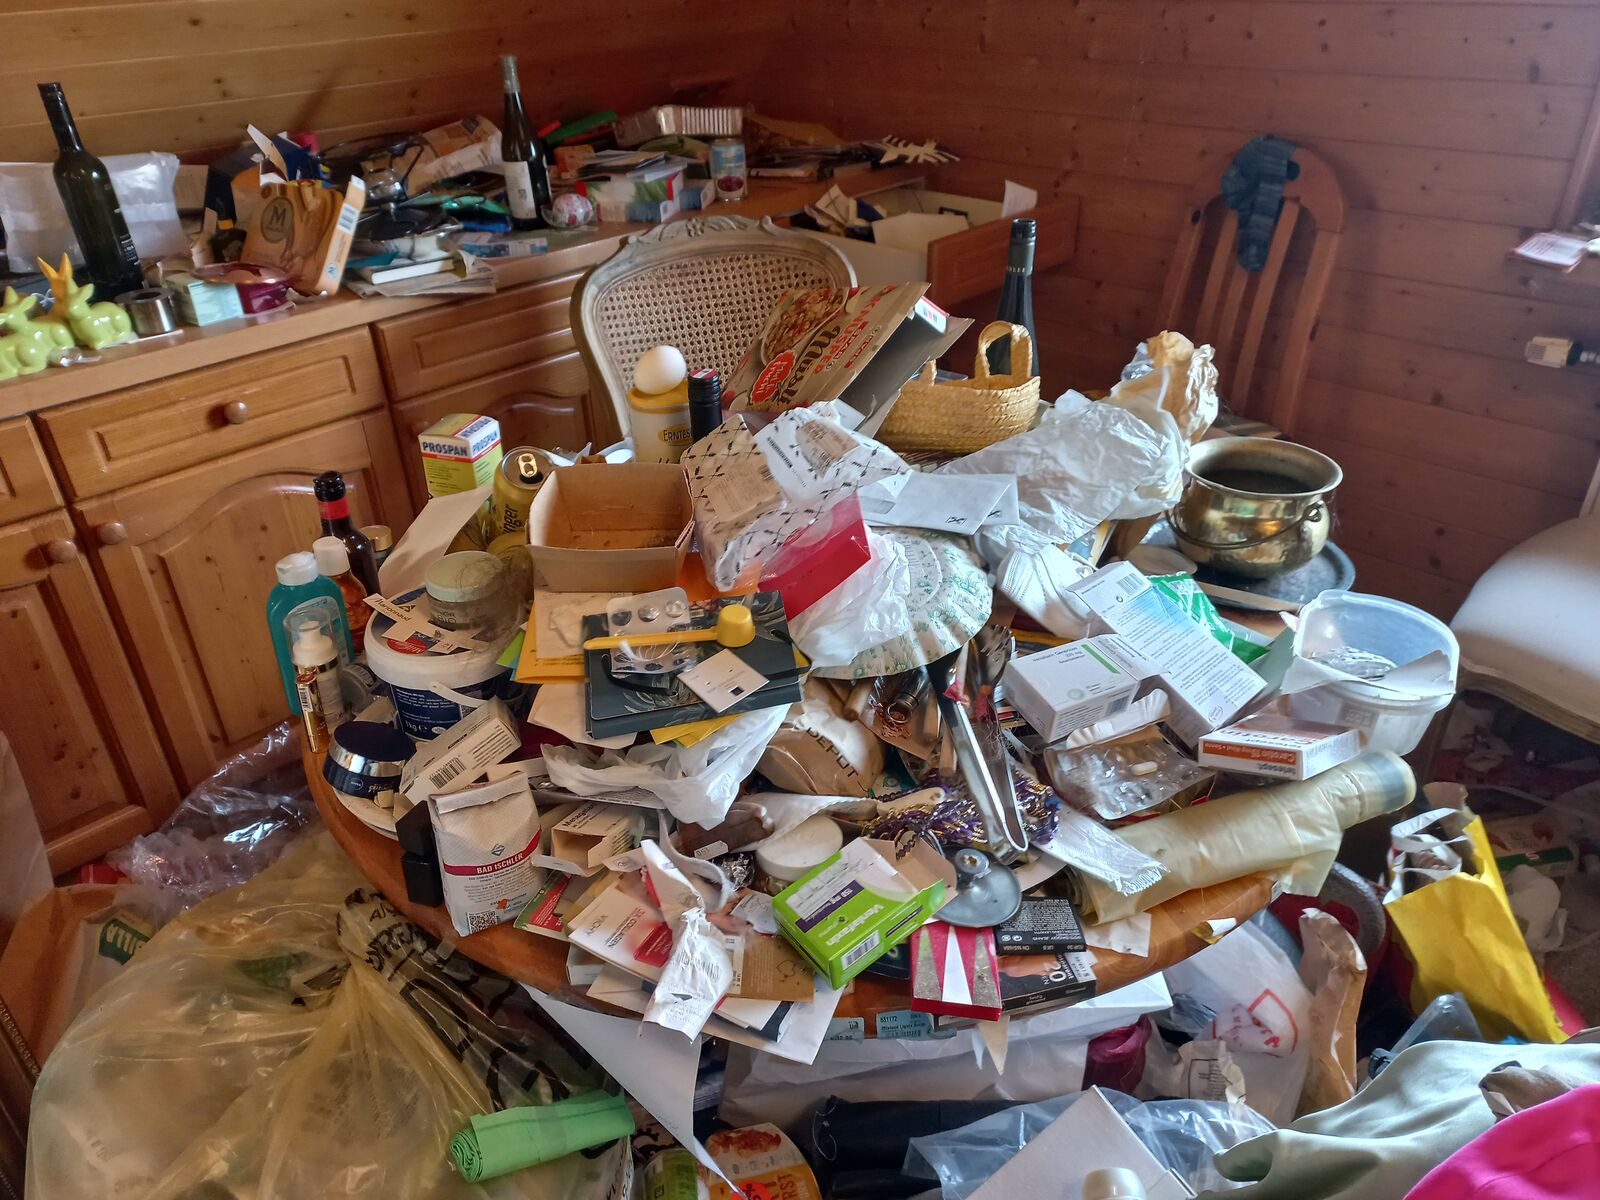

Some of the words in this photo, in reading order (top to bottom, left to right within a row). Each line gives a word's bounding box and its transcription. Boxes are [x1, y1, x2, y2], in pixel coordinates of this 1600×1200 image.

[777, 329, 841, 406] Müsli
[423, 442, 467, 456] PROSPAN
[499, 504, 521, 534] inger
[476, 866, 493, 875] BAD
[495, 852, 524, 870] ISCHLER
